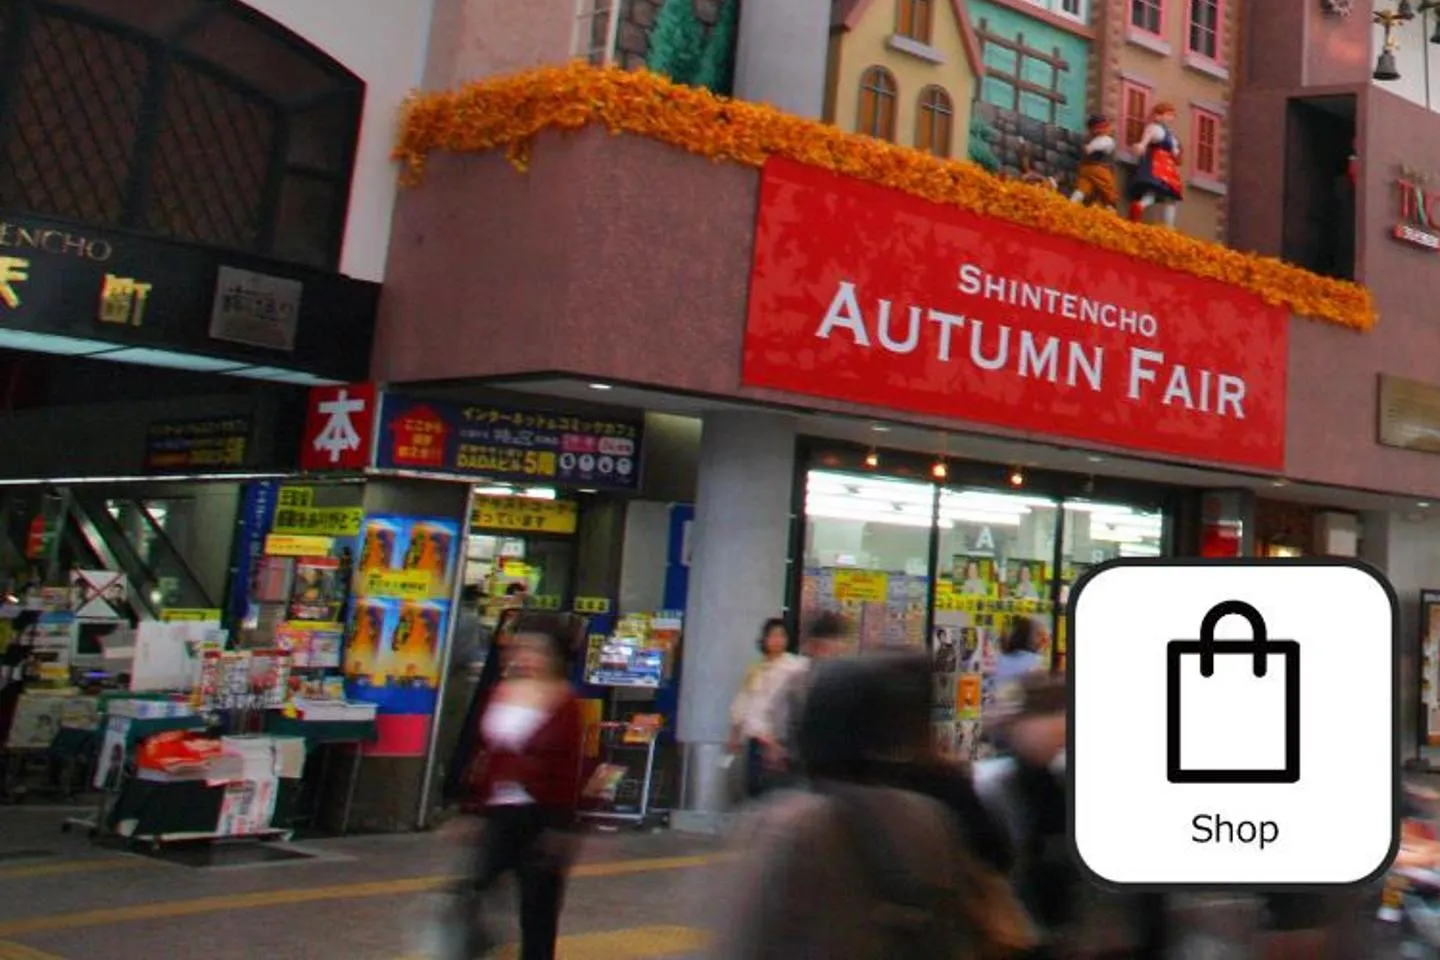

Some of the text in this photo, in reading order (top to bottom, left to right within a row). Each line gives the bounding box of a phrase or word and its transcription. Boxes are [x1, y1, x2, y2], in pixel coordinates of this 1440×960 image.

[957, 262, 1158, 338] SHINTENCHO
[815, 280, 1247, 420] AUTUMN FAIR
[312, 389, 366, 463] 本
